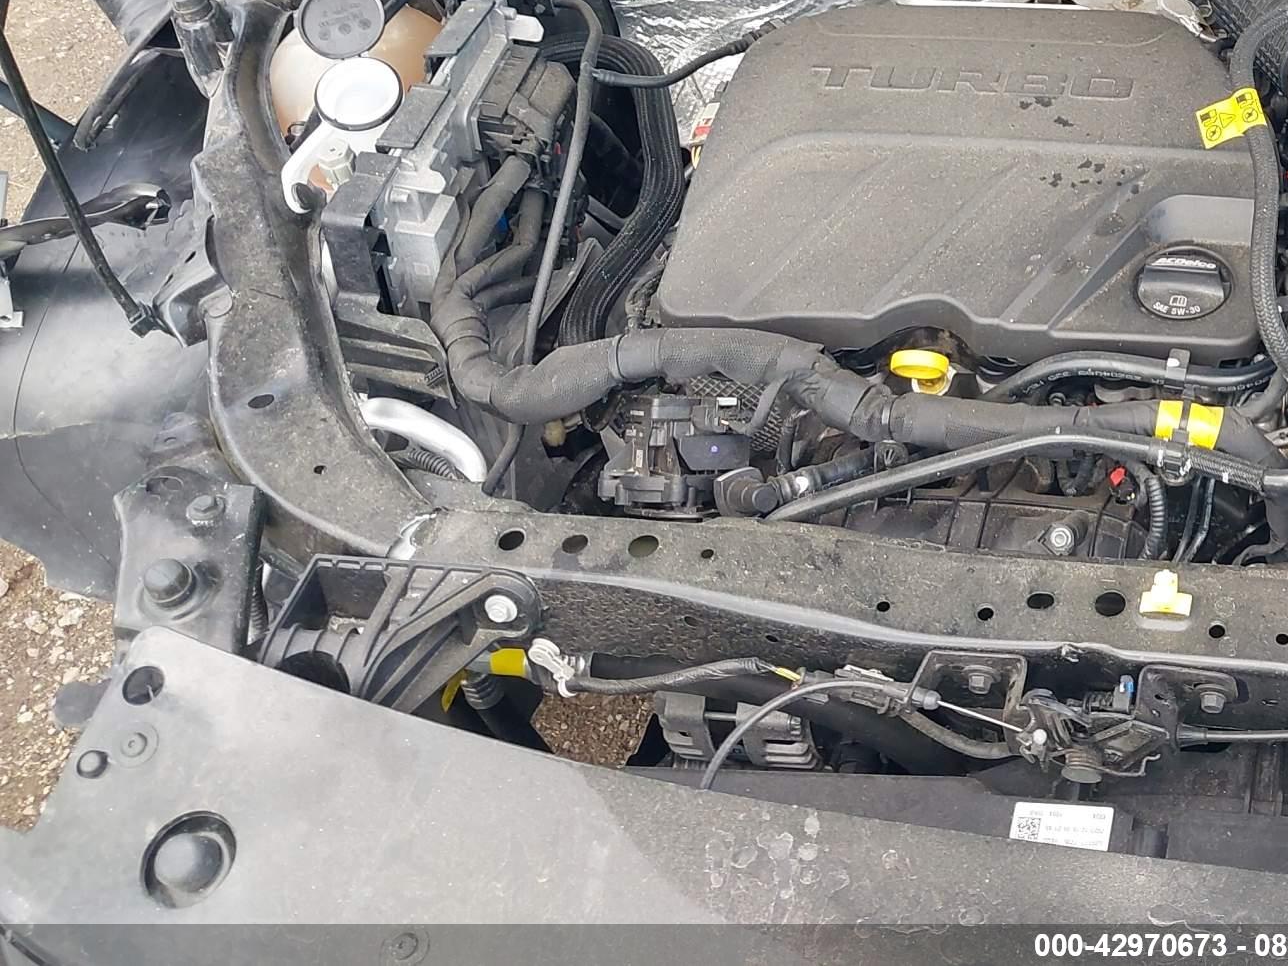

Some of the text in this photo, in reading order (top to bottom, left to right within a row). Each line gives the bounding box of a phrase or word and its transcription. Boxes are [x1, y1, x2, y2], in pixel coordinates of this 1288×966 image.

[811, 64, 1136, 101] TURBO
[1151, 257, 1217, 269] ACDelco
[1153, 301, 1201, 315] SAE 5W-30
